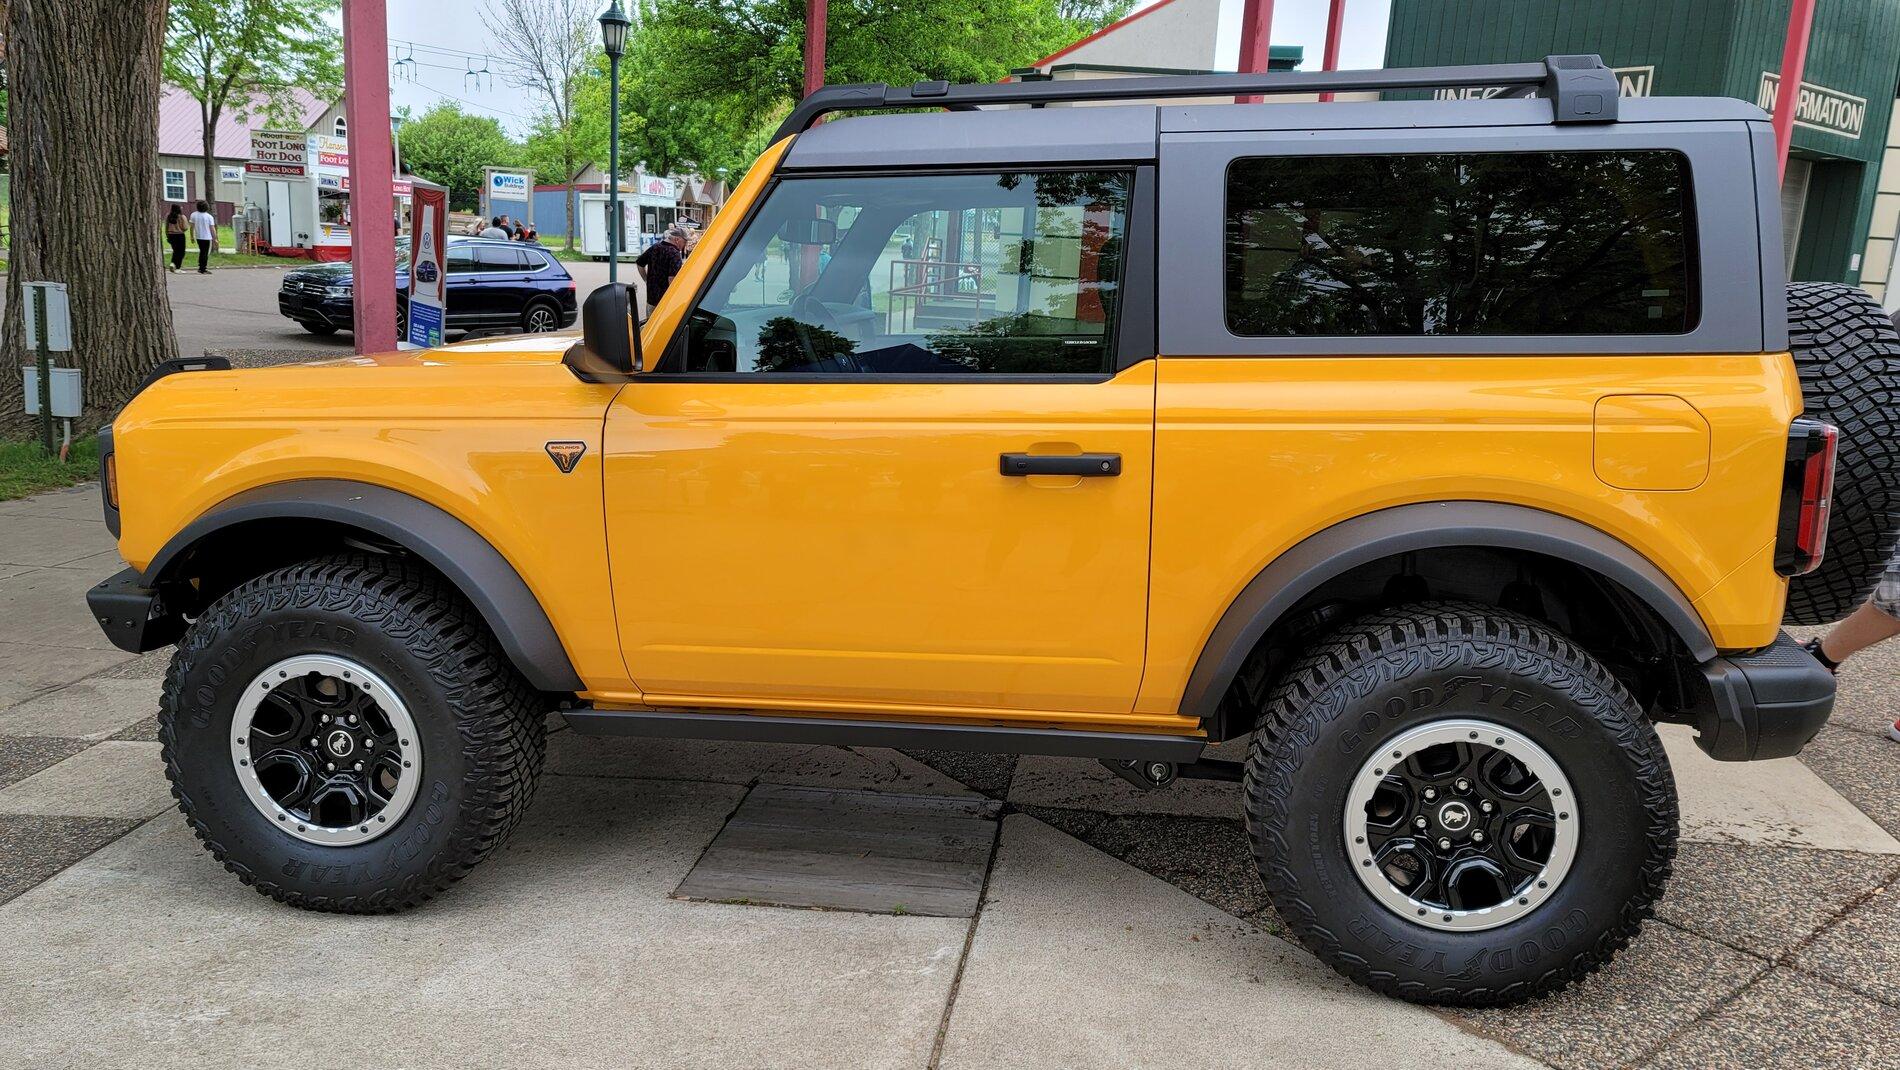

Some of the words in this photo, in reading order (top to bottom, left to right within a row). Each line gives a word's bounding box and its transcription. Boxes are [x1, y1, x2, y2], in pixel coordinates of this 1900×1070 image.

[1760, 80, 1863, 132] INRMATION
[251, 139, 277, 150] FOOT
[280, 141, 306, 151] LONG
[256, 150, 277, 160] HOT
[279, 152, 302, 162] DOG
[320, 155, 337, 164] FOOT
[262, 165, 280, 173] CORN
[281, 167, 301, 175] DOGS
[503, 176, 525, 185] Wick
